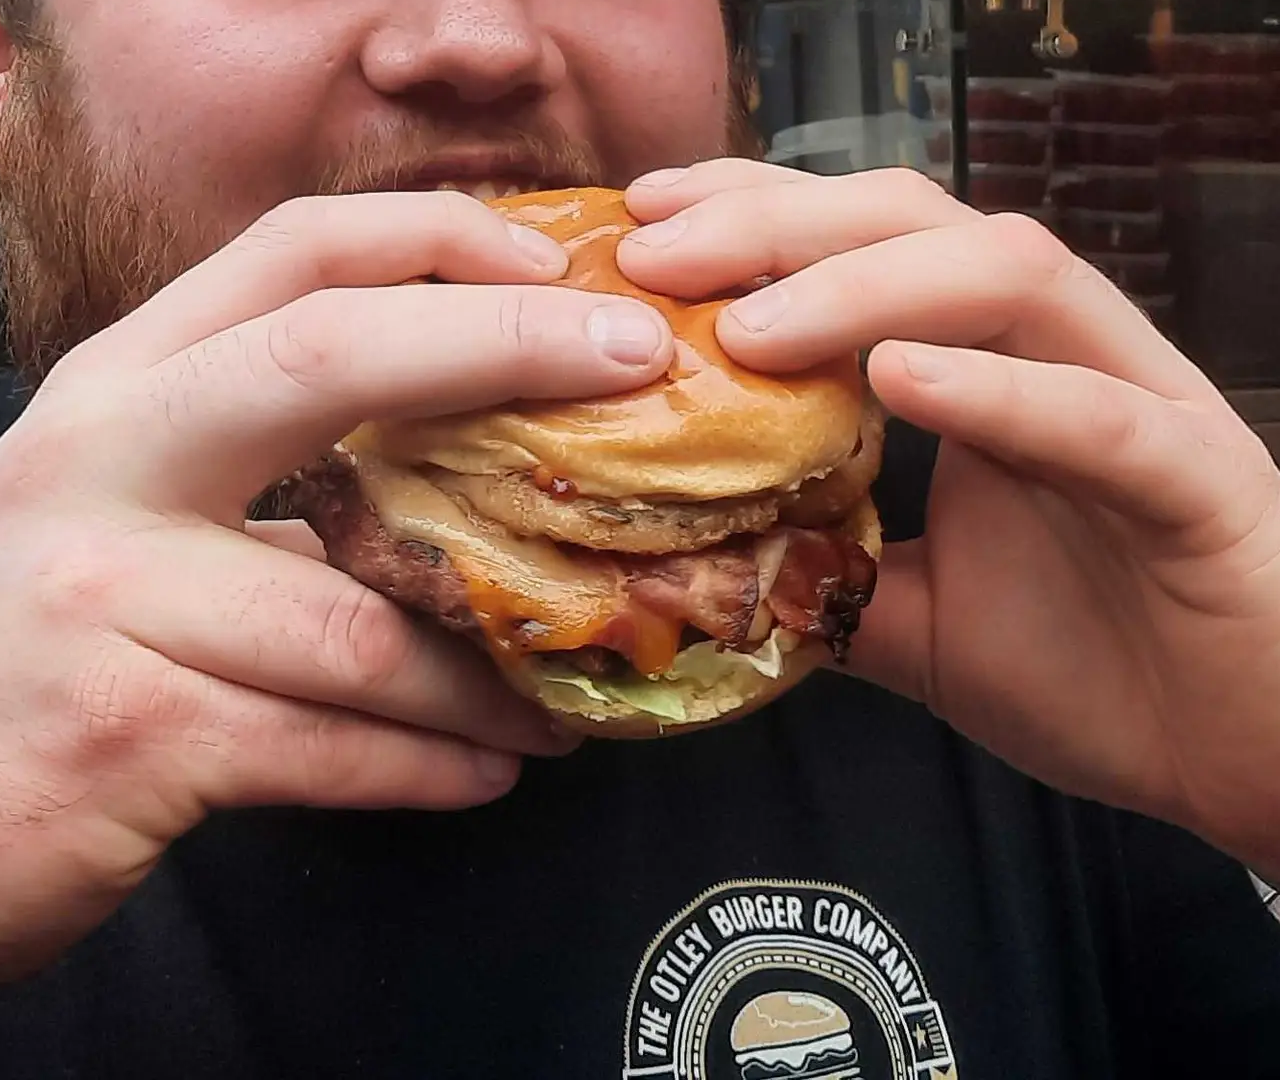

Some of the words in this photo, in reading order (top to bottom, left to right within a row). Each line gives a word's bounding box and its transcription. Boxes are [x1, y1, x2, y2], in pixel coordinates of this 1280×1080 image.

[709, 895, 805, 939] BURGER
[649, 921, 714, 1003] OTLEY
[813, 898, 922, 1005] COMPANY
[638, 1001, 672, 1056] THE
